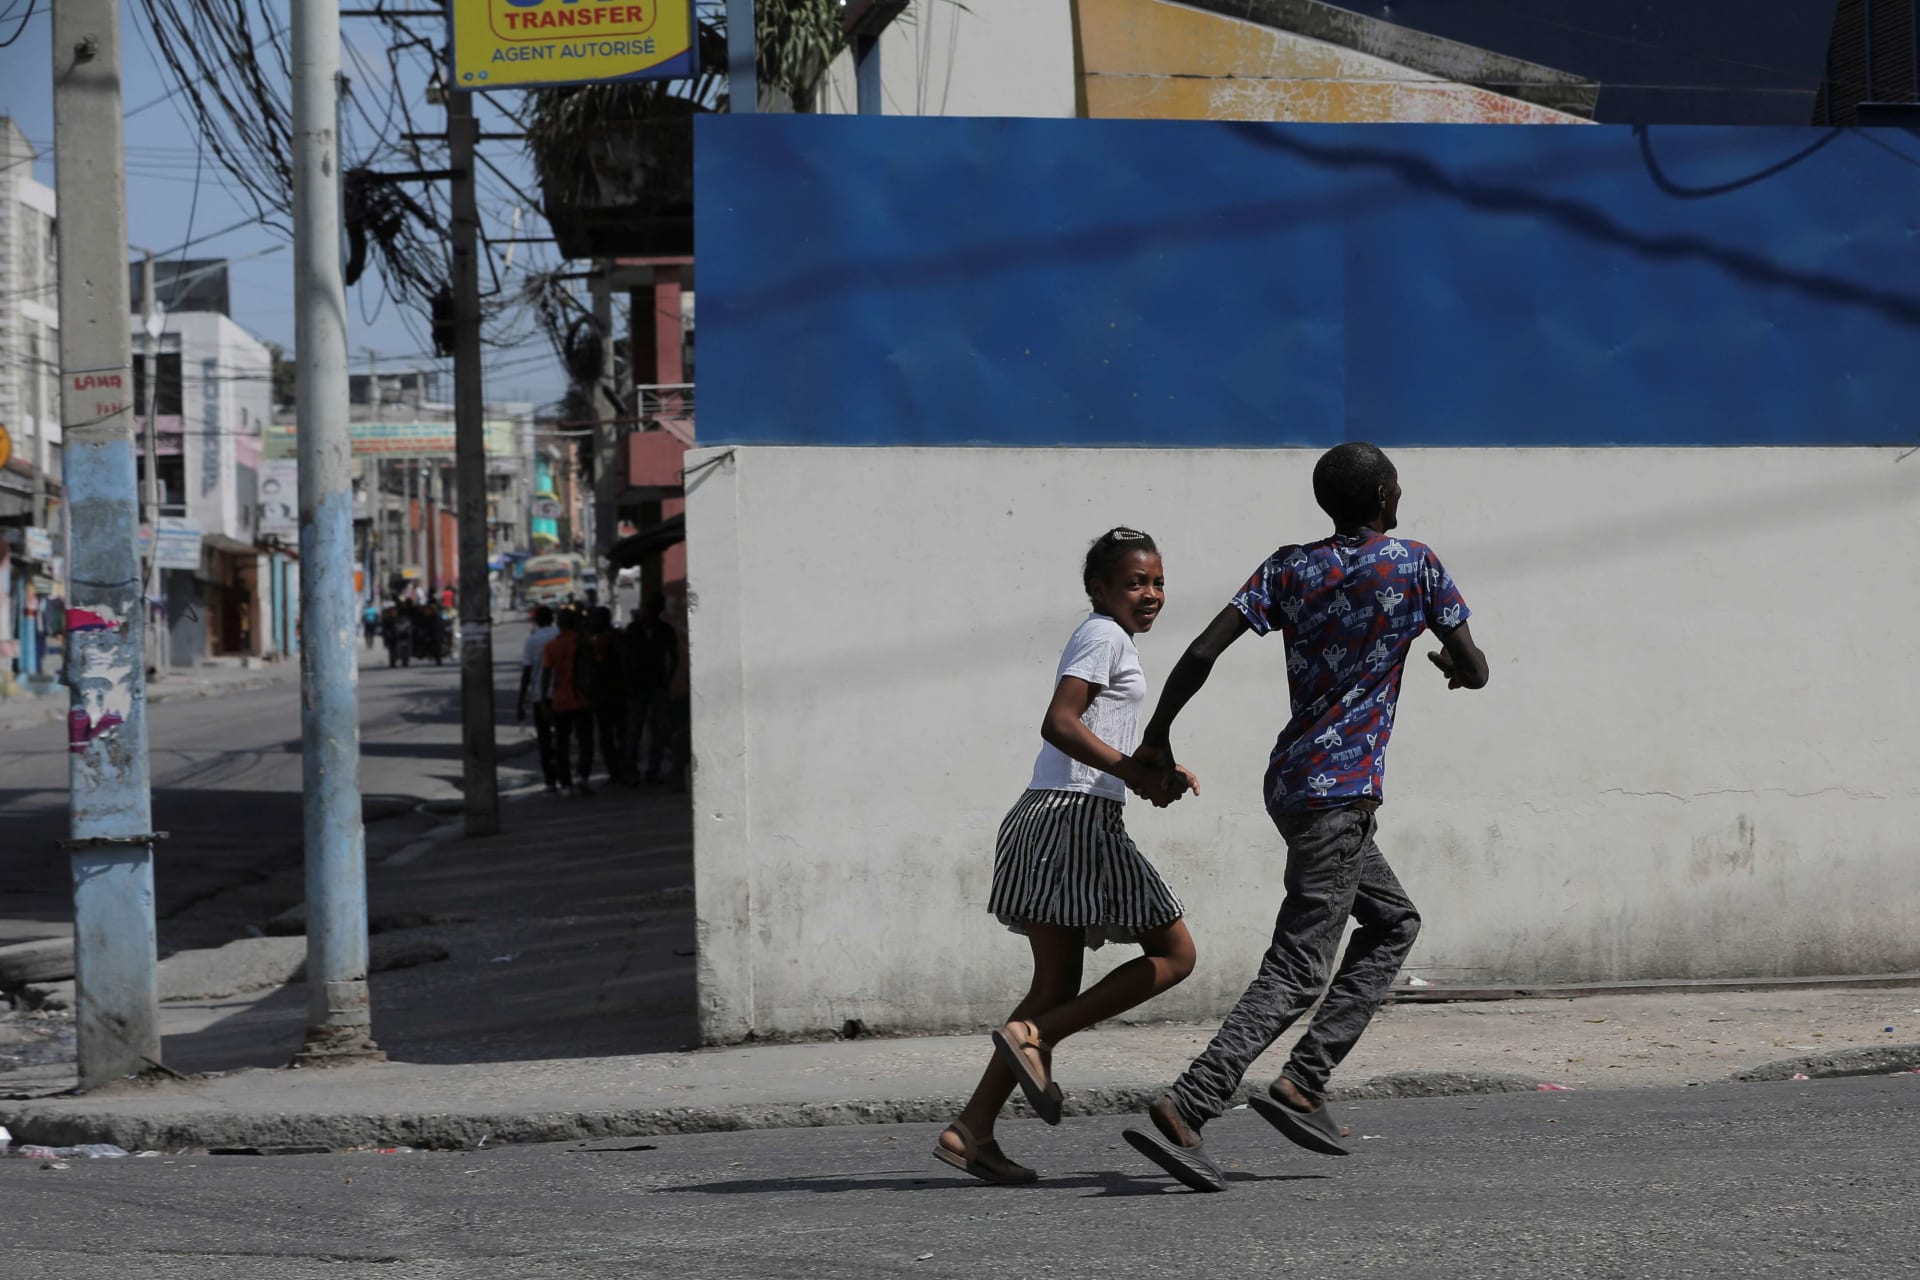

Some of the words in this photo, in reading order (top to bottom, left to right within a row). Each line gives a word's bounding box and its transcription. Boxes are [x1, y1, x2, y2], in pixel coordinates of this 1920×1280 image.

[504, 6, 643, 30] TRANSFER
[492, 44, 555, 62] AGENT
[560, 37, 655, 58] AUTORISÉ
